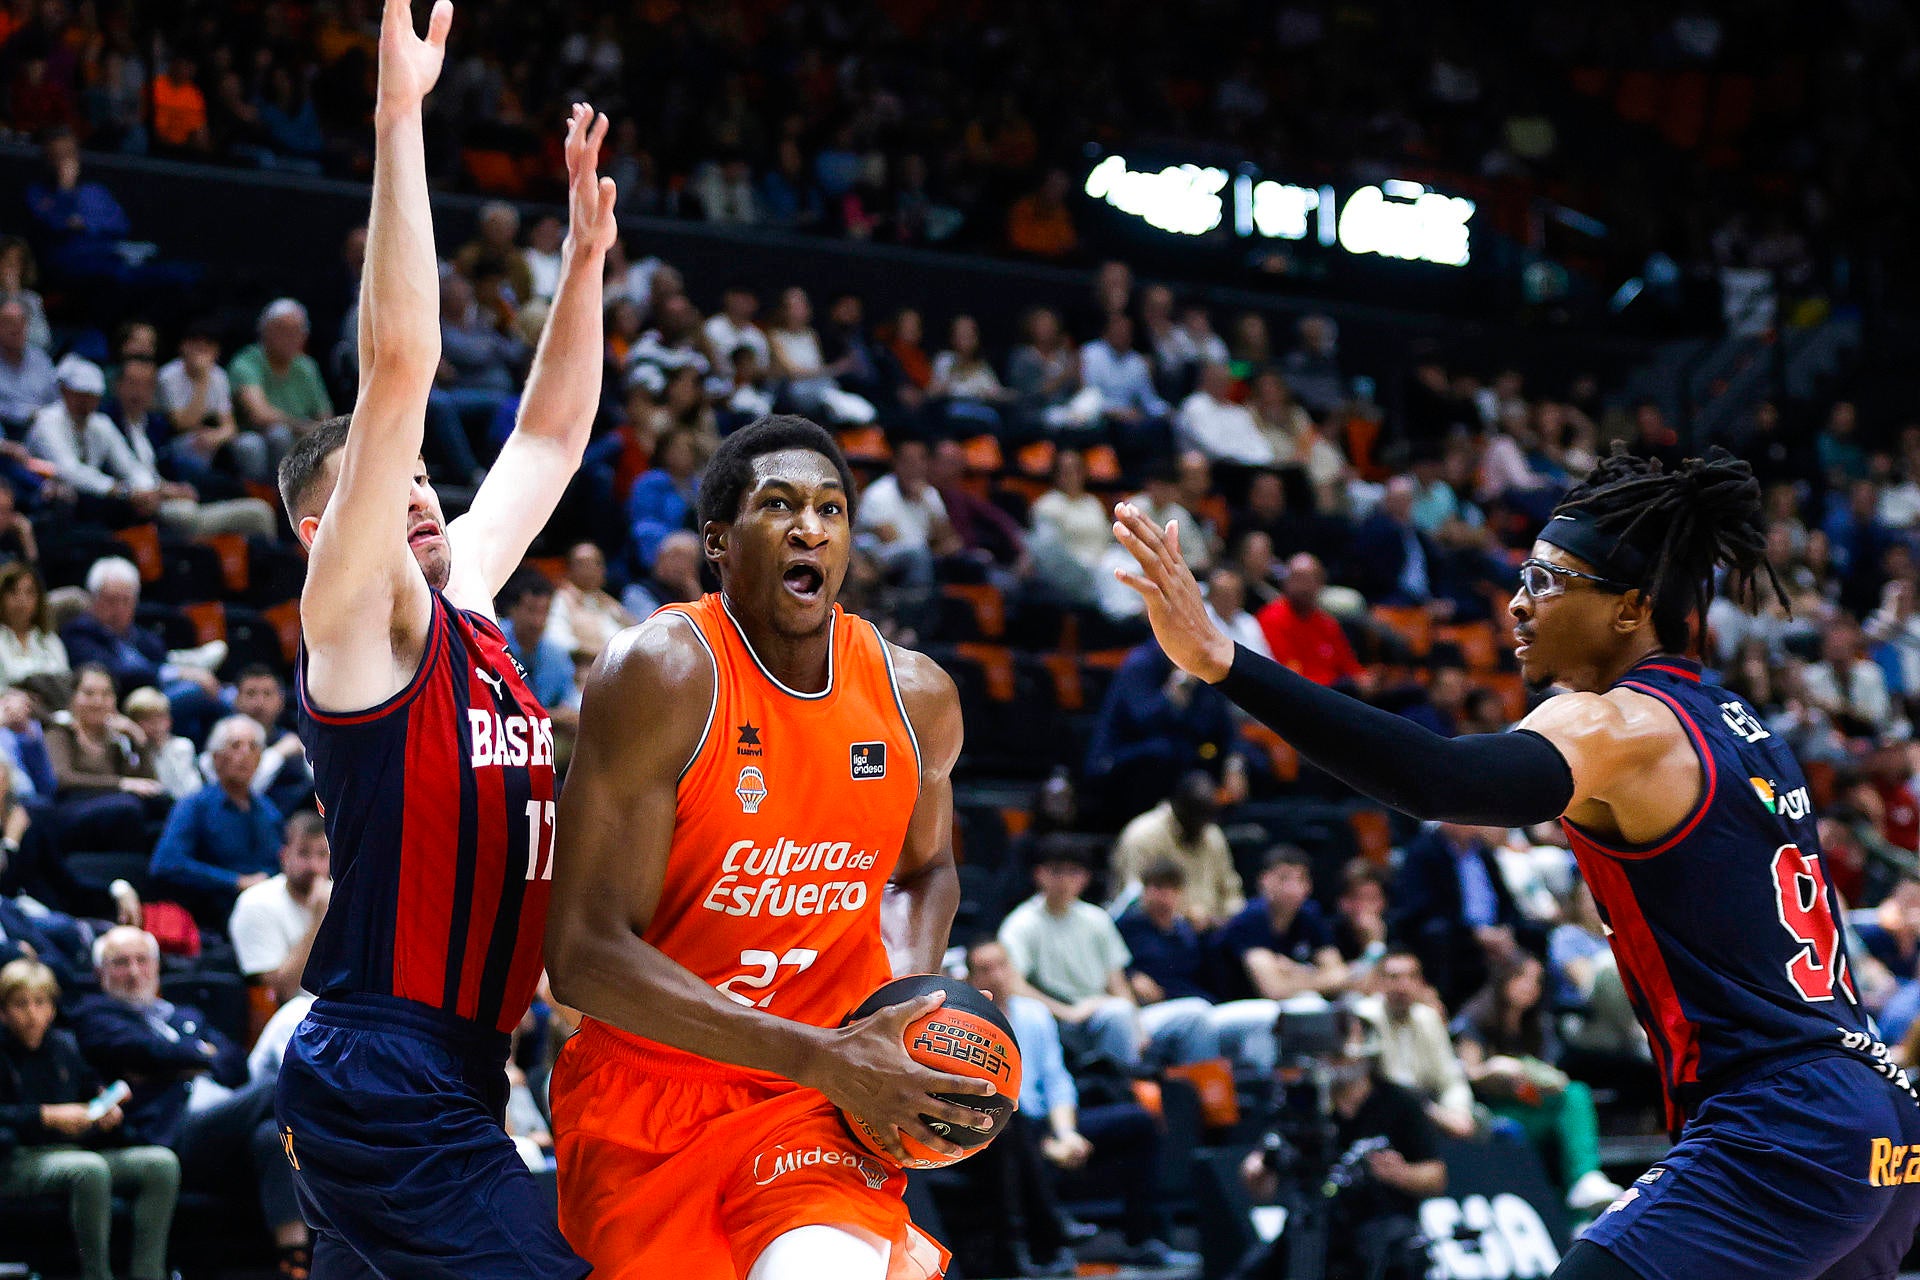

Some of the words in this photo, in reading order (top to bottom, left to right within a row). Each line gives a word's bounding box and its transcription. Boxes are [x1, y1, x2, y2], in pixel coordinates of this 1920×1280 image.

[853, 753, 868, 766] liga
[853, 763, 884, 775] endesa
[525, 799, 556, 881] 17
[721, 836, 852, 877] Cultura
[846, 849, 880, 870] del
[702, 874, 868, 918] Esfuerzo
[1770, 843, 1858, 1005] 9
[927, 1021, 992, 1049] 1000
[913, 1032, 1012, 1083] LEGACY
[764, 1145, 857, 1180] Midea
